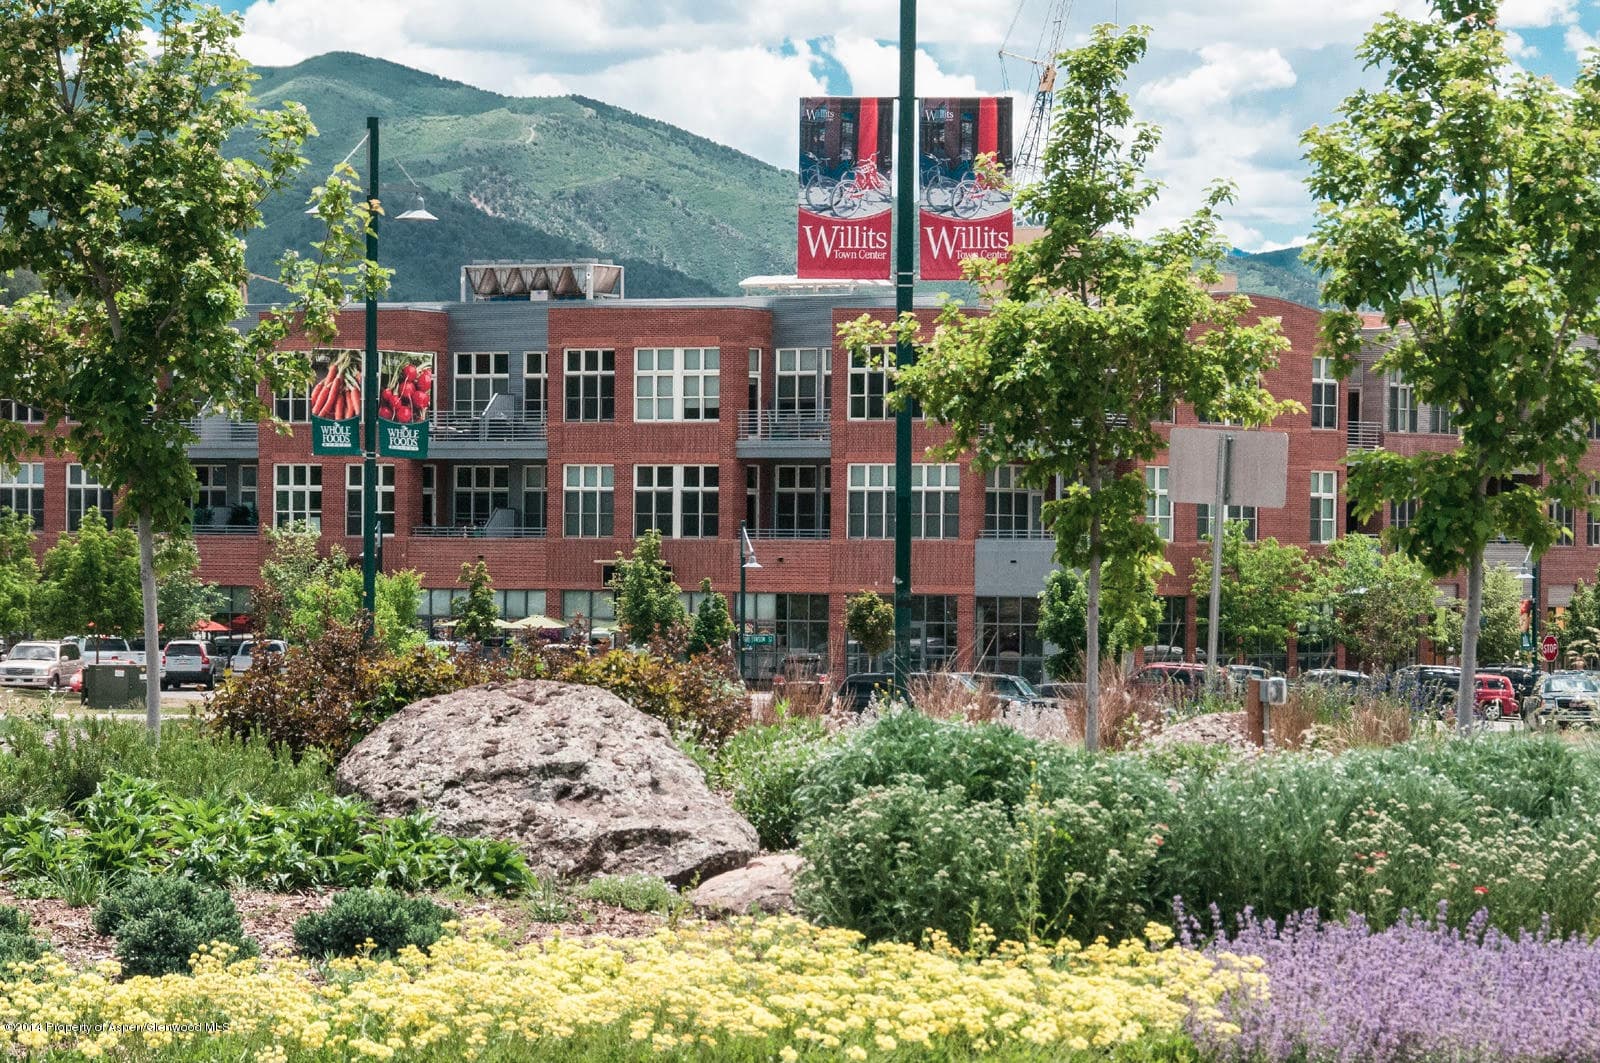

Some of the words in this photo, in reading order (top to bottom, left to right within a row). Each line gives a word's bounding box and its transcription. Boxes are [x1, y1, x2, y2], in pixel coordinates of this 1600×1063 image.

[802, 225, 887, 259] Willits
[923, 226, 1009, 260] Willits
[833, 249, 857, 259] Town
[858, 249, 887, 260] Center
[320, 425, 351, 435] WHOLE
[387, 428, 420, 438] WHOLE
[322, 434, 351, 443] FOODS
[390, 437, 418, 447] FOODS
[1543, 644, 1557, 653] STOP
